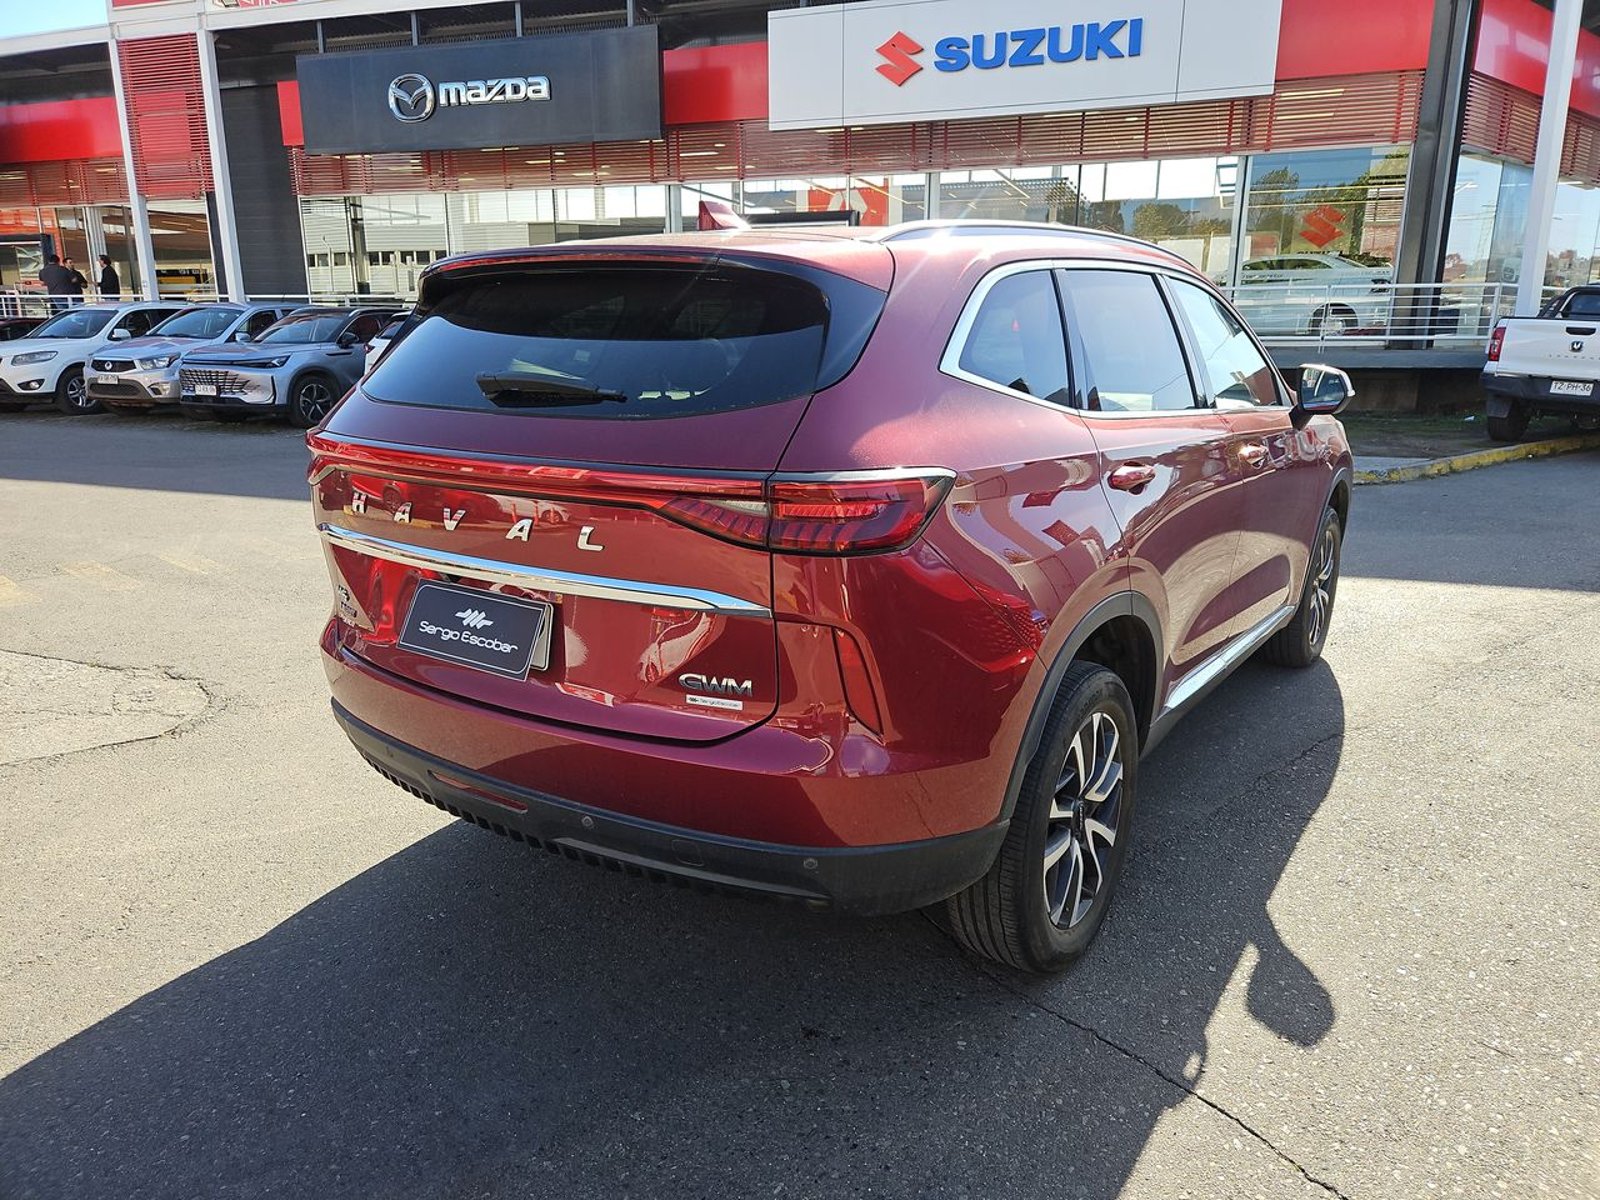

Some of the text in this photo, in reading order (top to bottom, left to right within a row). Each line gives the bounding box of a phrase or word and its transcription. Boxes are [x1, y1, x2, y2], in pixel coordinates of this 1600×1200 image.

[934, 18, 1143, 72] SUZUKI
[351, 490, 604, 551] HAVAL
[418, 620, 519, 654] Sergo Escobar
[678, 673, 753, 697] GWM
